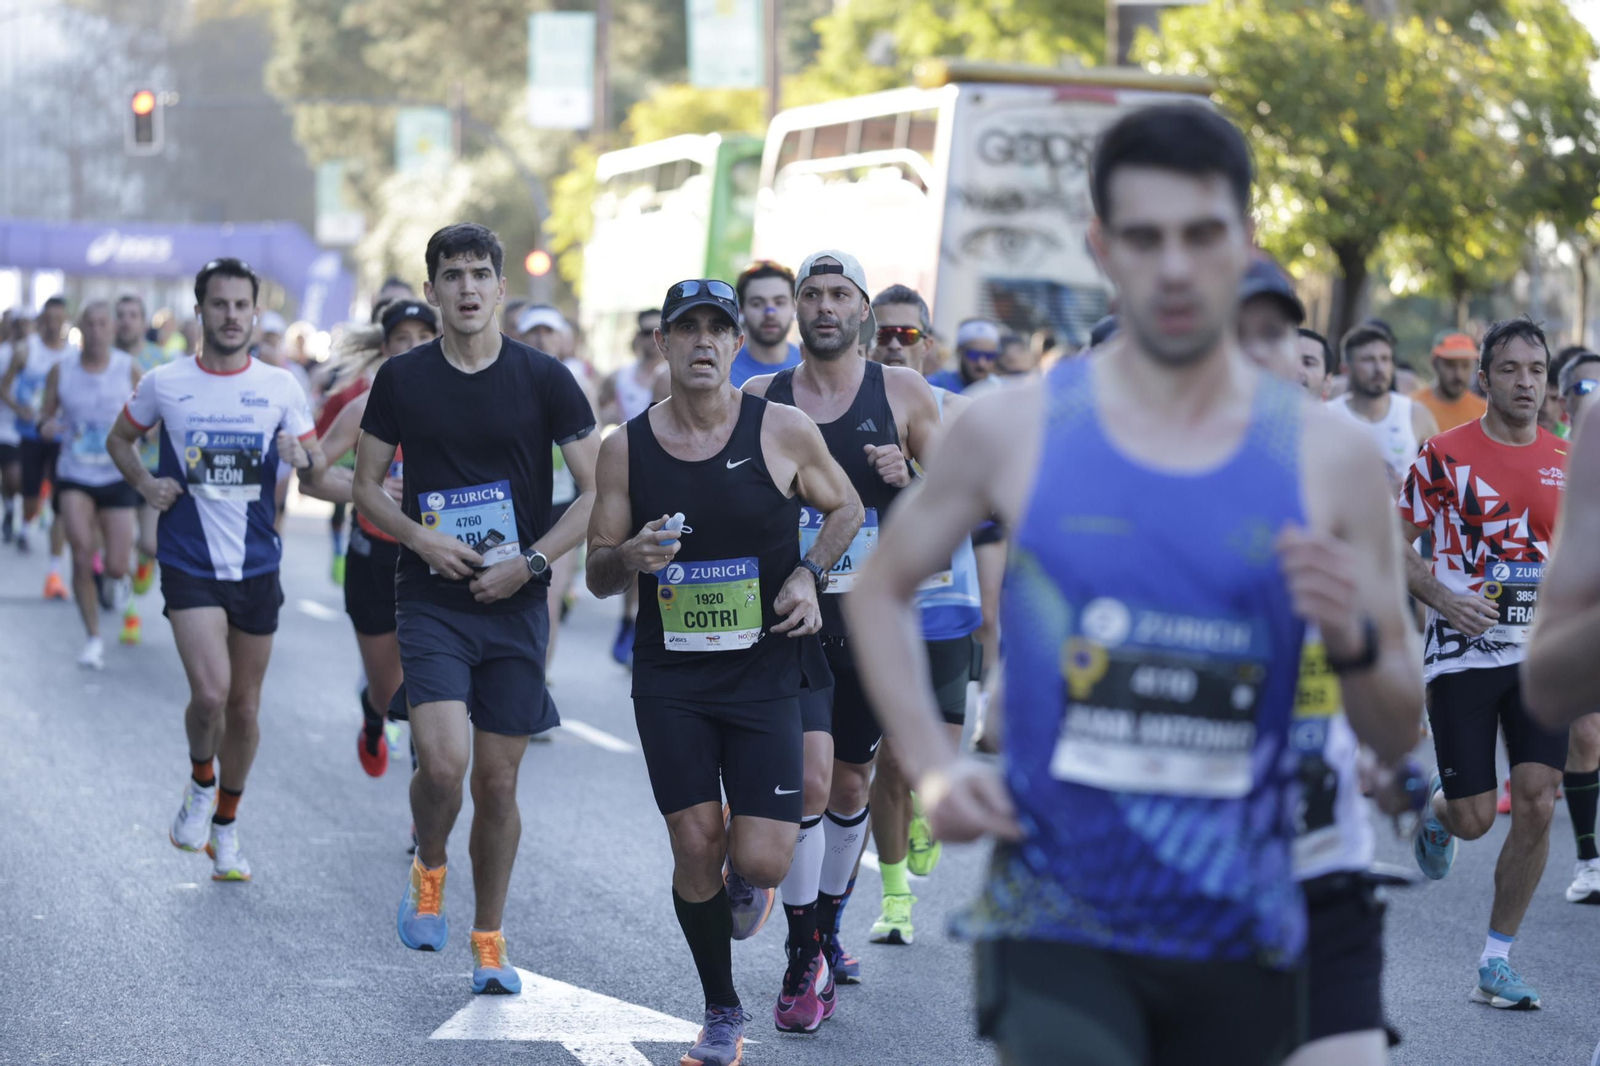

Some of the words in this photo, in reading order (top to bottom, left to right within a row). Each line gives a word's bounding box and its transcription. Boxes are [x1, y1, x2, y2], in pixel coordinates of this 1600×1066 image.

[213, 435, 256, 446] ZURICH
[205, 465, 243, 484] LEÓN
[450, 488, 499, 505] ZURICH
[455, 515, 482, 528] 4760
[690, 564, 747, 580] ZURICH
[694, 592, 724, 605] 1920
[1516, 590, 1537, 602] 3854
[683, 609, 739, 629] COTRI
